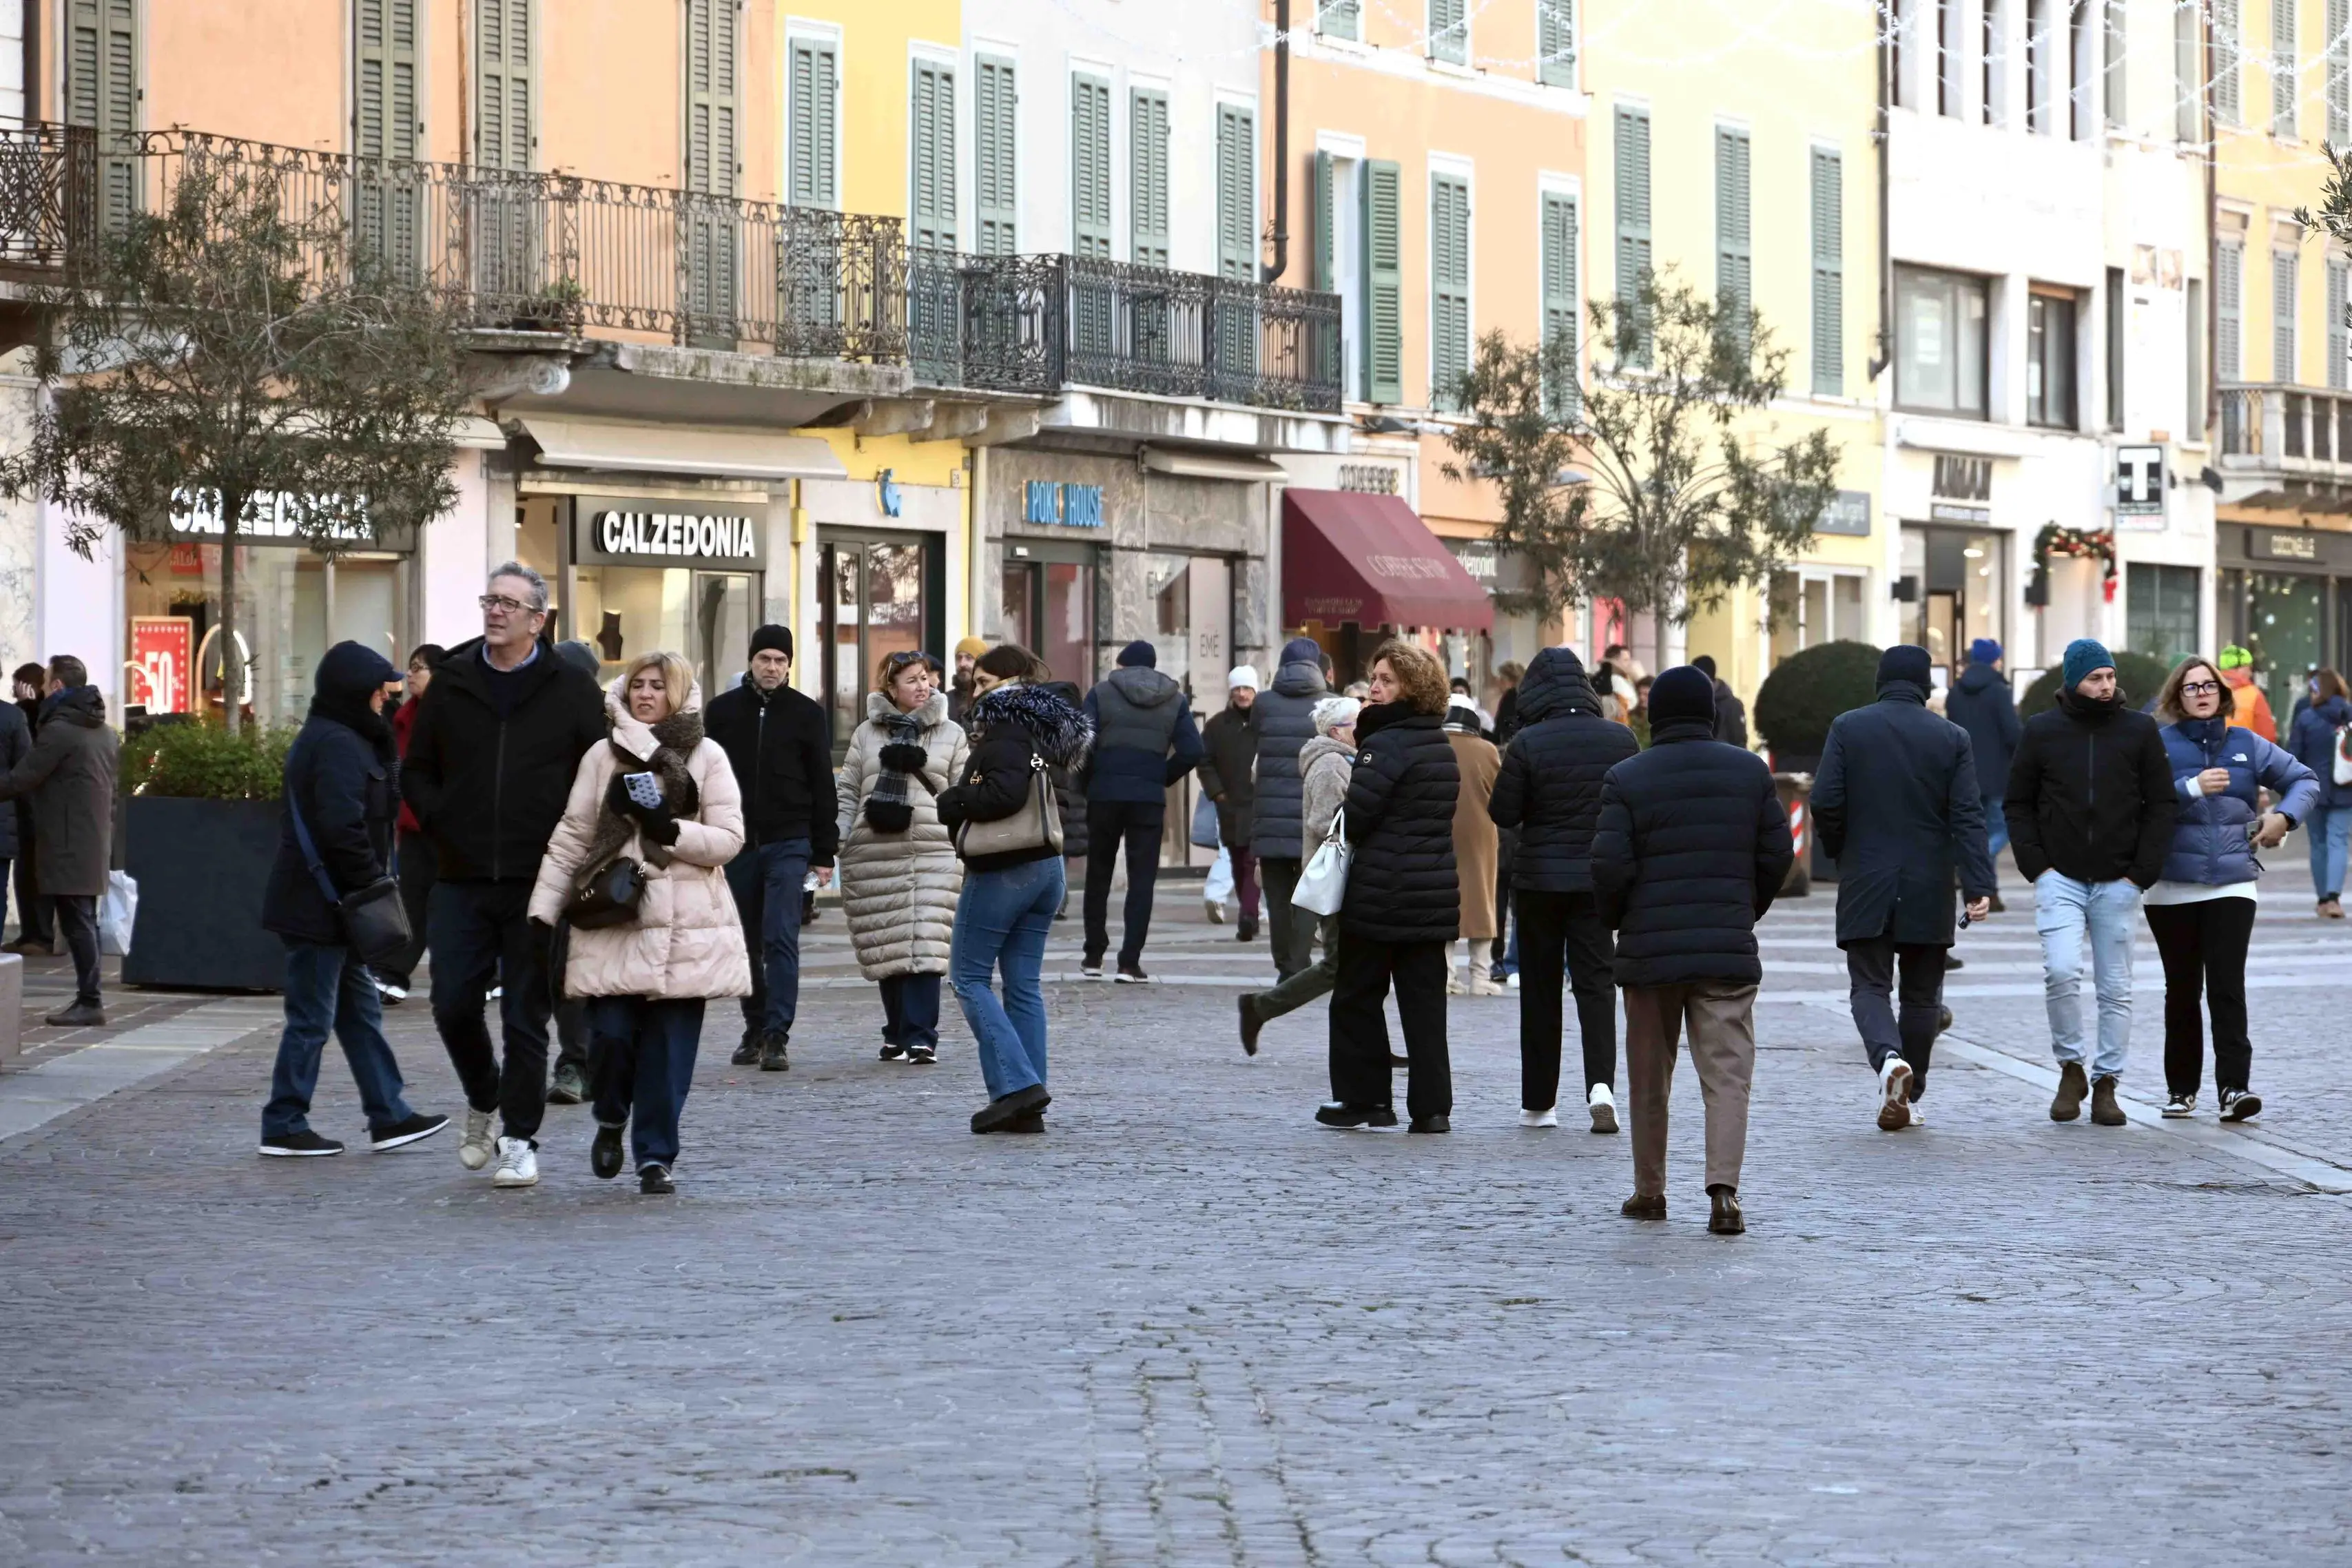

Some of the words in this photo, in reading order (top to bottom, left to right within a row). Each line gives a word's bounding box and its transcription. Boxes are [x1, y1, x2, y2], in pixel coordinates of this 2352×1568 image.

[1027, 480, 1060, 524] POKE
[1065, 484, 1105, 528] HOUSE
[603, 510, 755, 557] CALZEDONIA
